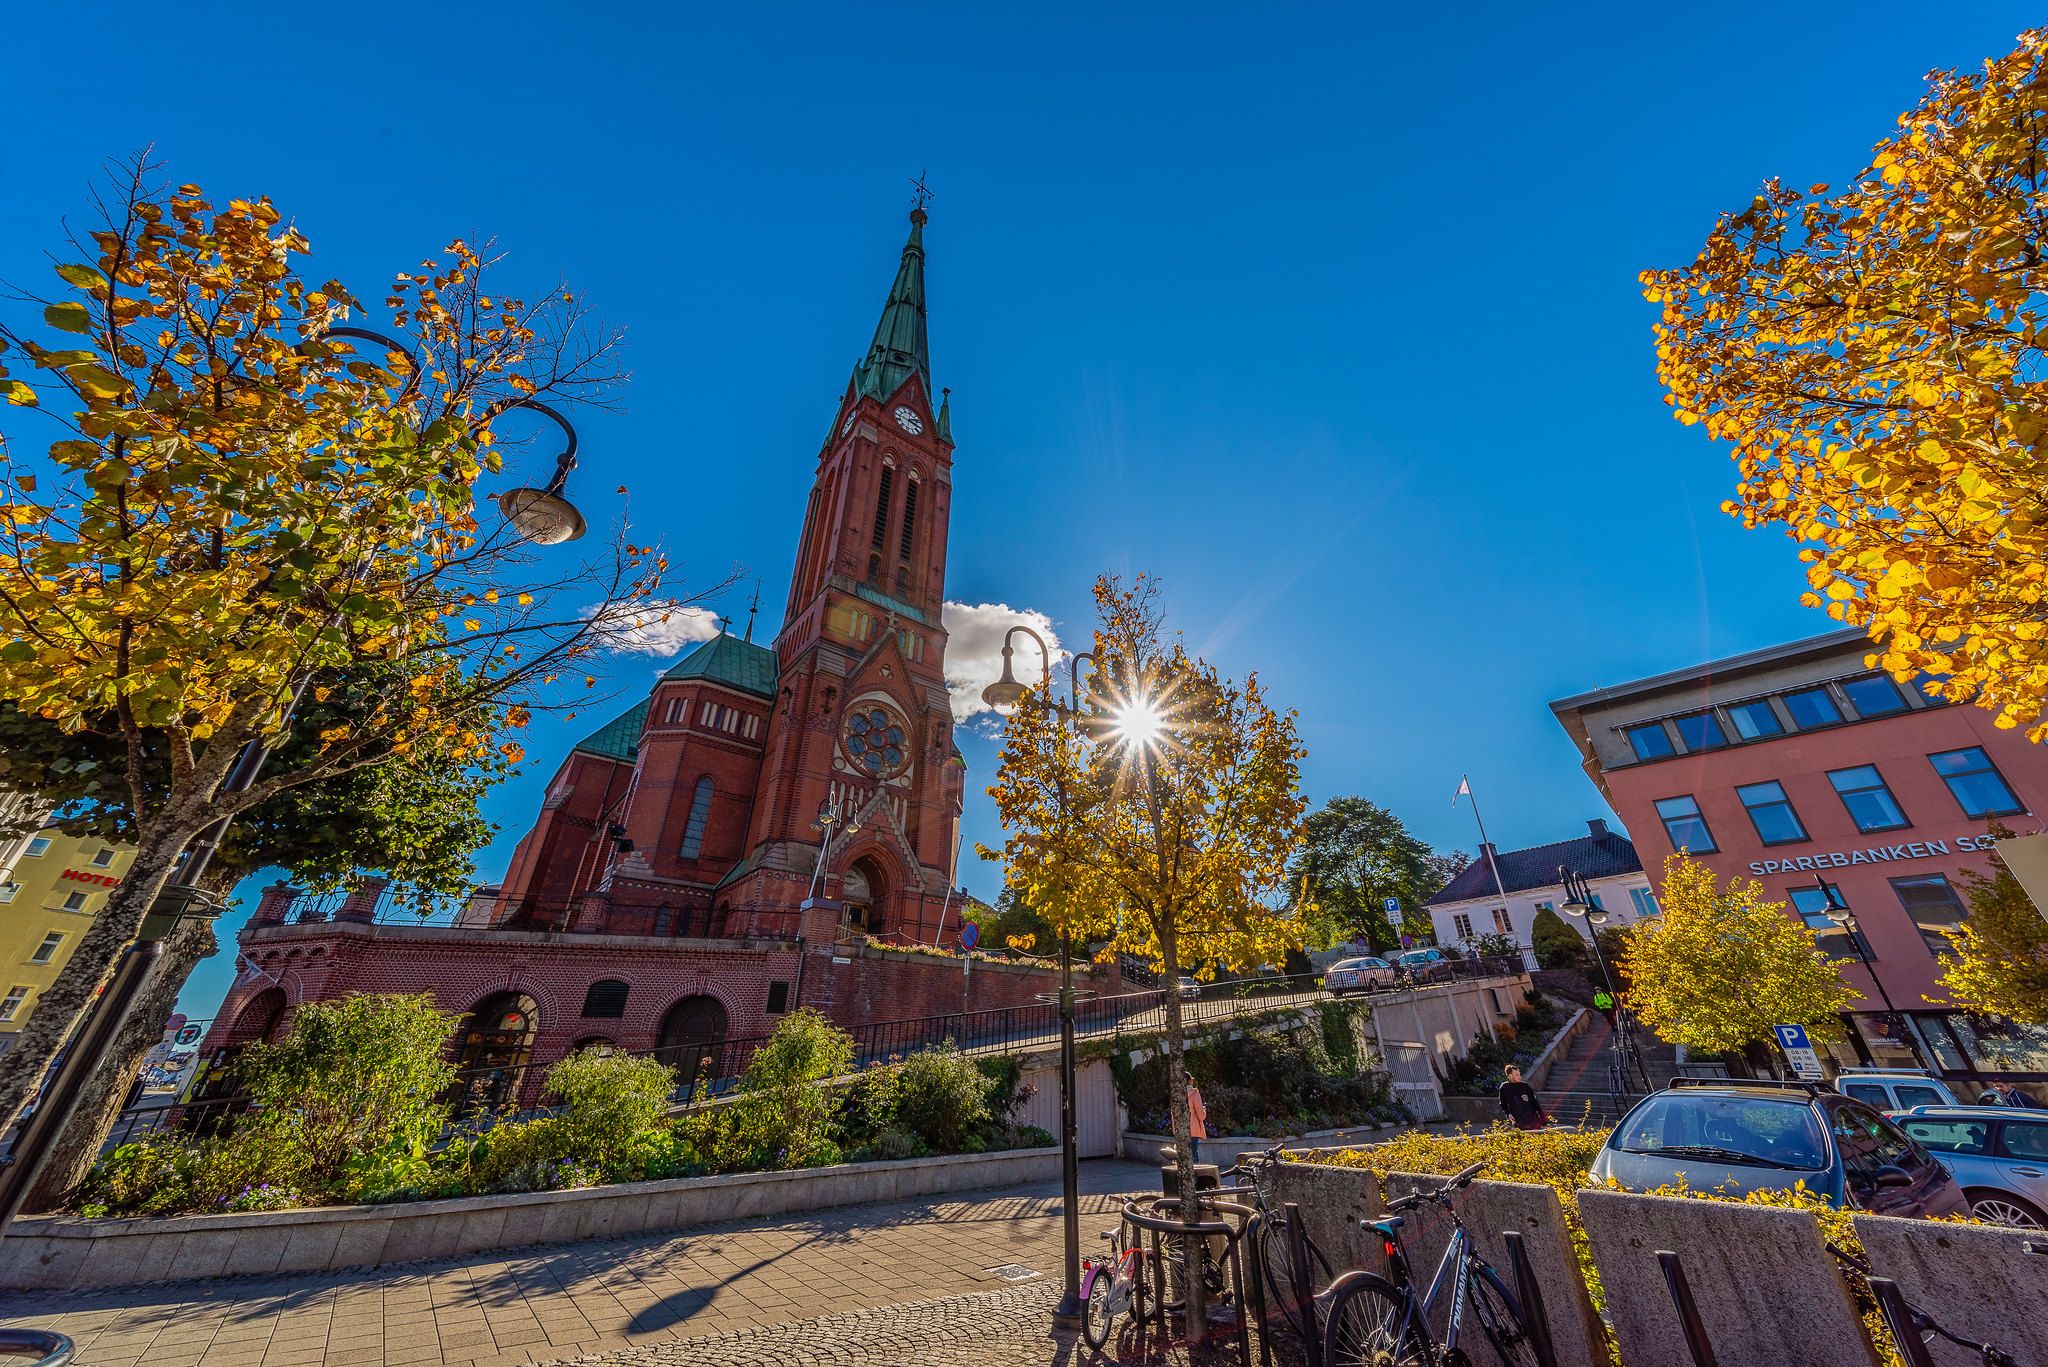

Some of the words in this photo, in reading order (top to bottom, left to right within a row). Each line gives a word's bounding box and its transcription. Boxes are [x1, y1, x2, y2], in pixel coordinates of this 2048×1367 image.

[1749, 840, 1949, 876] SPAREBANKEN
[1387, 899, 1395, 910] P
[1781, 1027, 1799, 1046] P
